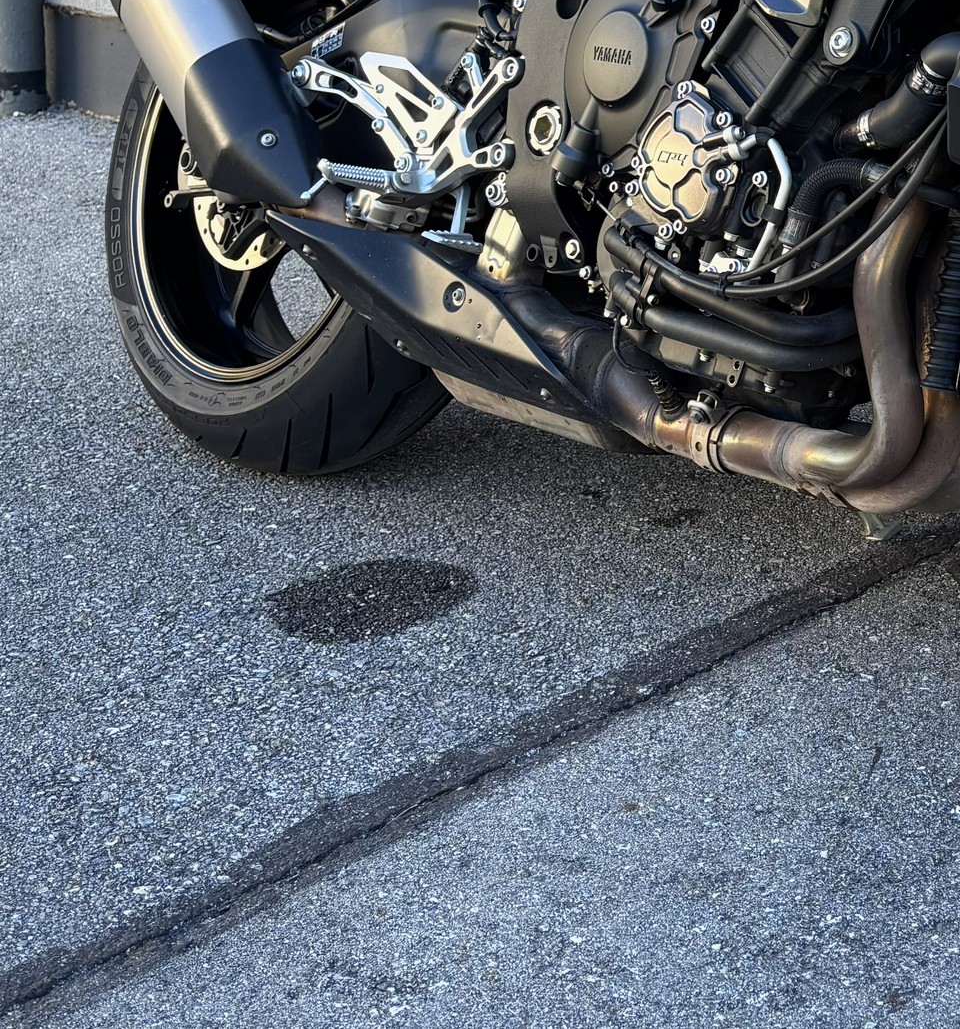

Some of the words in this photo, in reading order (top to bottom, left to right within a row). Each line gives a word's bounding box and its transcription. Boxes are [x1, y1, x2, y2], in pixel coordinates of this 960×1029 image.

[593, 46, 632, 66] YAMAHA
[657, 150, 689, 166] CP4
[111, 206, 126, 289] ROSSO
[126, 315, 172, 386] DIABLO
